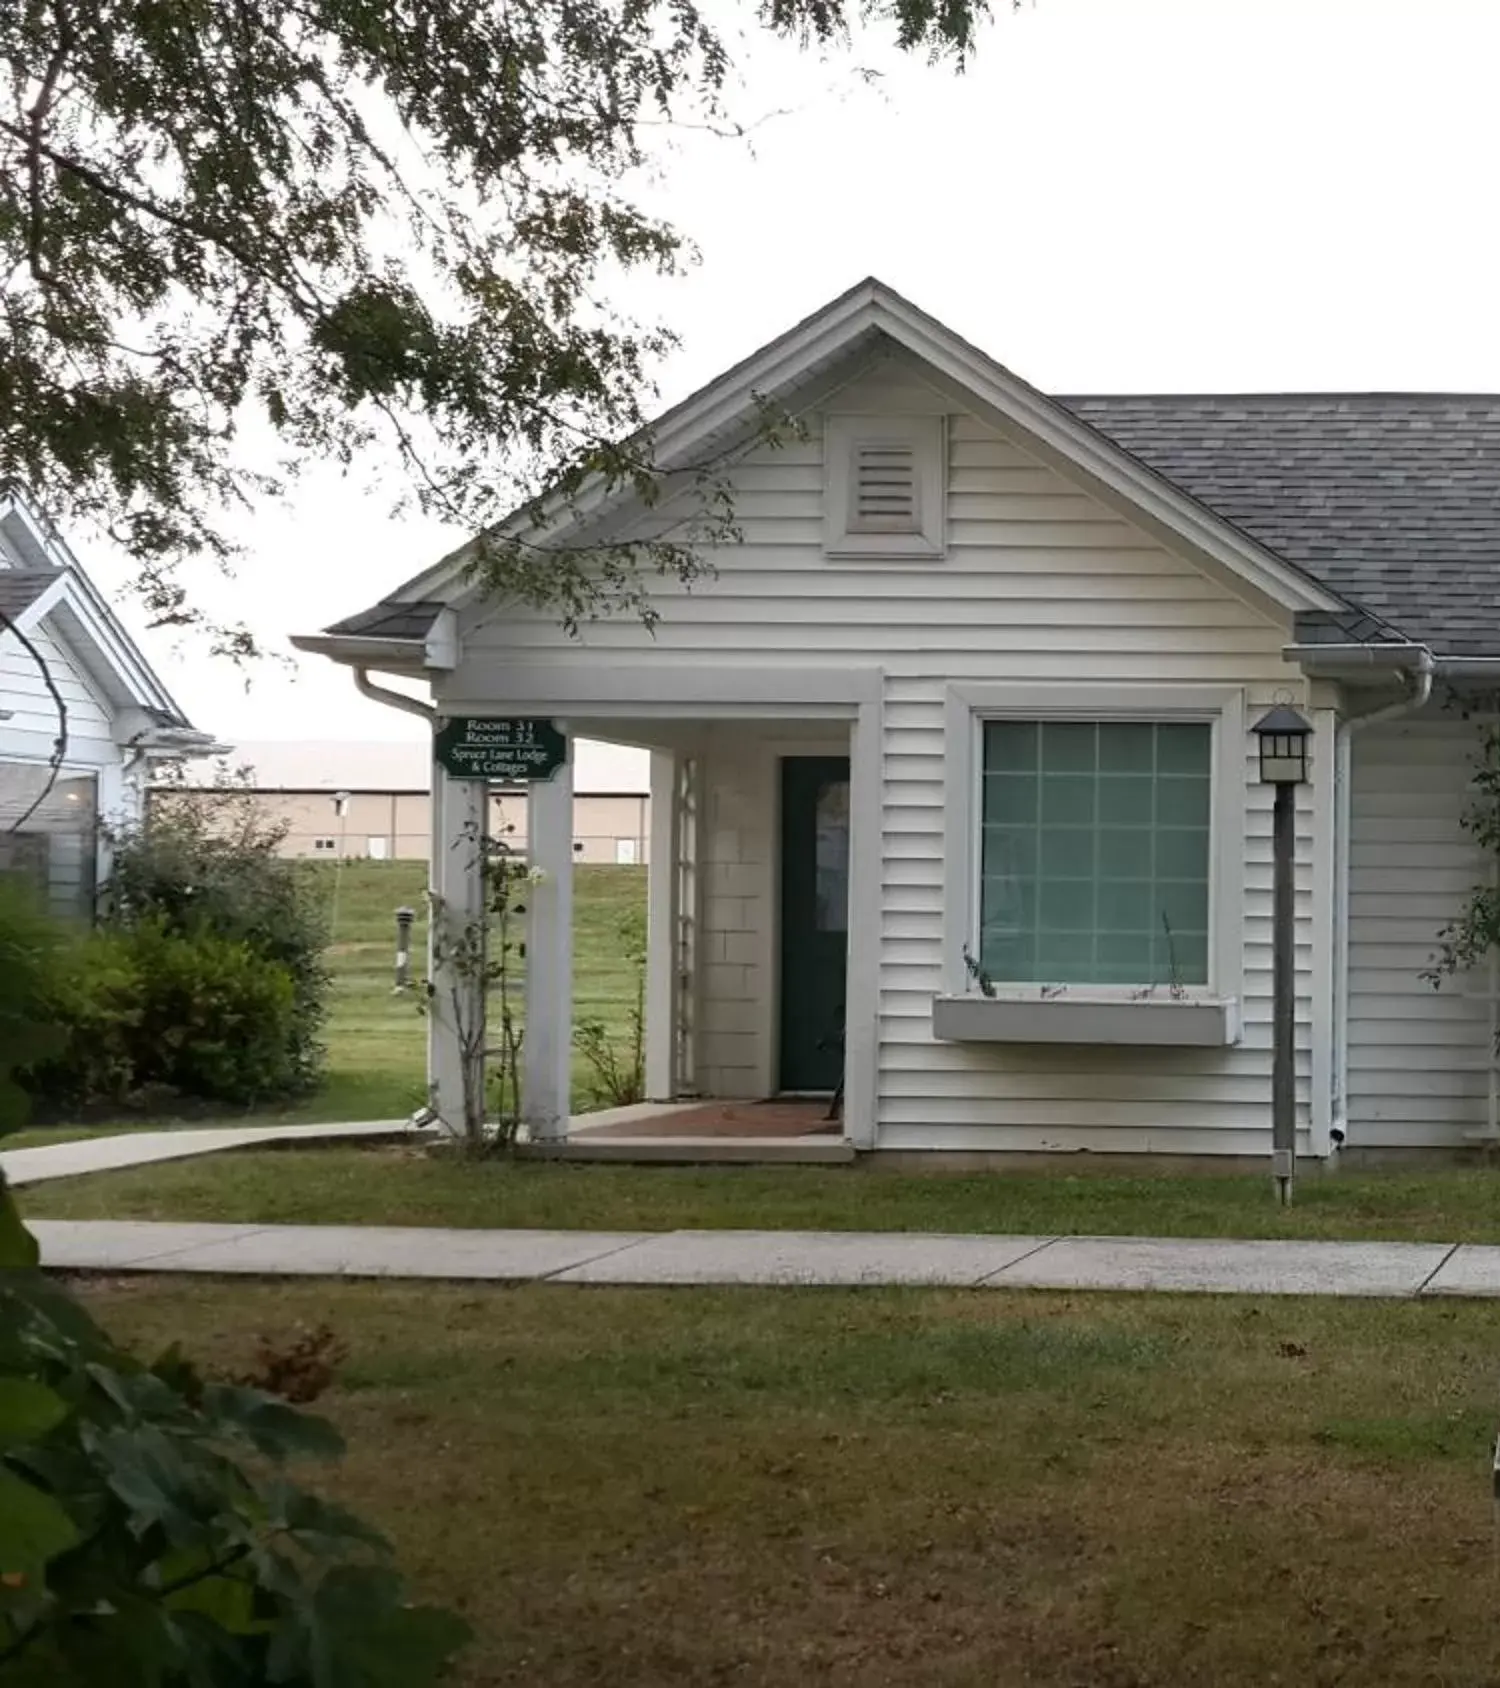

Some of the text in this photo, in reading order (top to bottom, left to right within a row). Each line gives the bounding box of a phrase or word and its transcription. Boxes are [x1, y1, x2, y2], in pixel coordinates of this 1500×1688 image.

[466, 719, 511, 731] Room
[465, 732, 510, 743] Room
[450, 747, 549, 765] Spruce Lane Lodge
[471, 761, 528, 776] & Cottages
